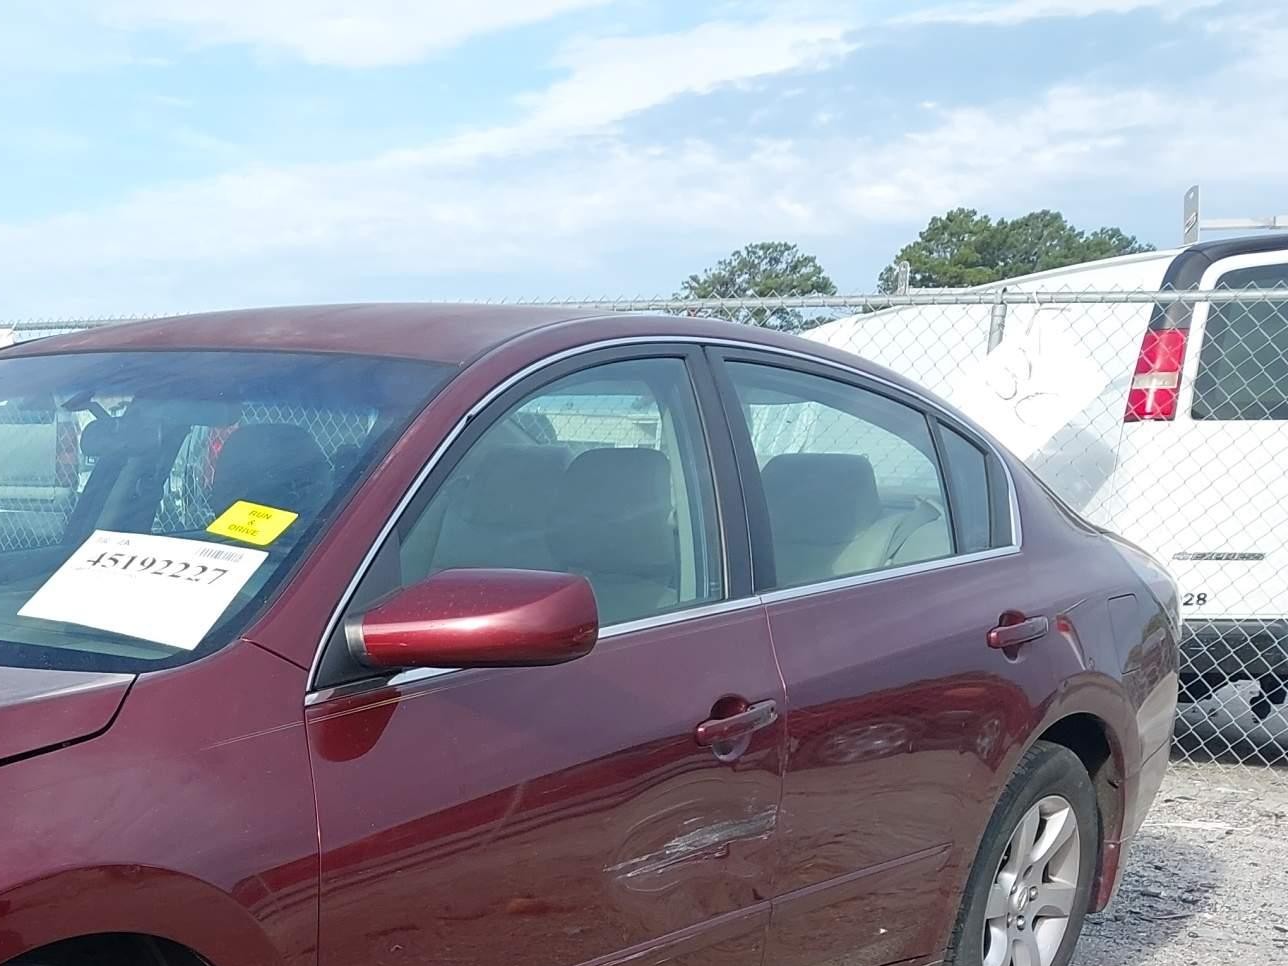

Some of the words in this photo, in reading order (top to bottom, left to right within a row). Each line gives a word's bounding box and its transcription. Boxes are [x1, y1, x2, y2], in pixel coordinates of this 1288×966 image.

[248, 510, 272, 520] RUN
[228, 524, 259, 537] DRIVE
[86, 551, 229, 585] 45192227
[1182, 592, 1208, 606] 28
